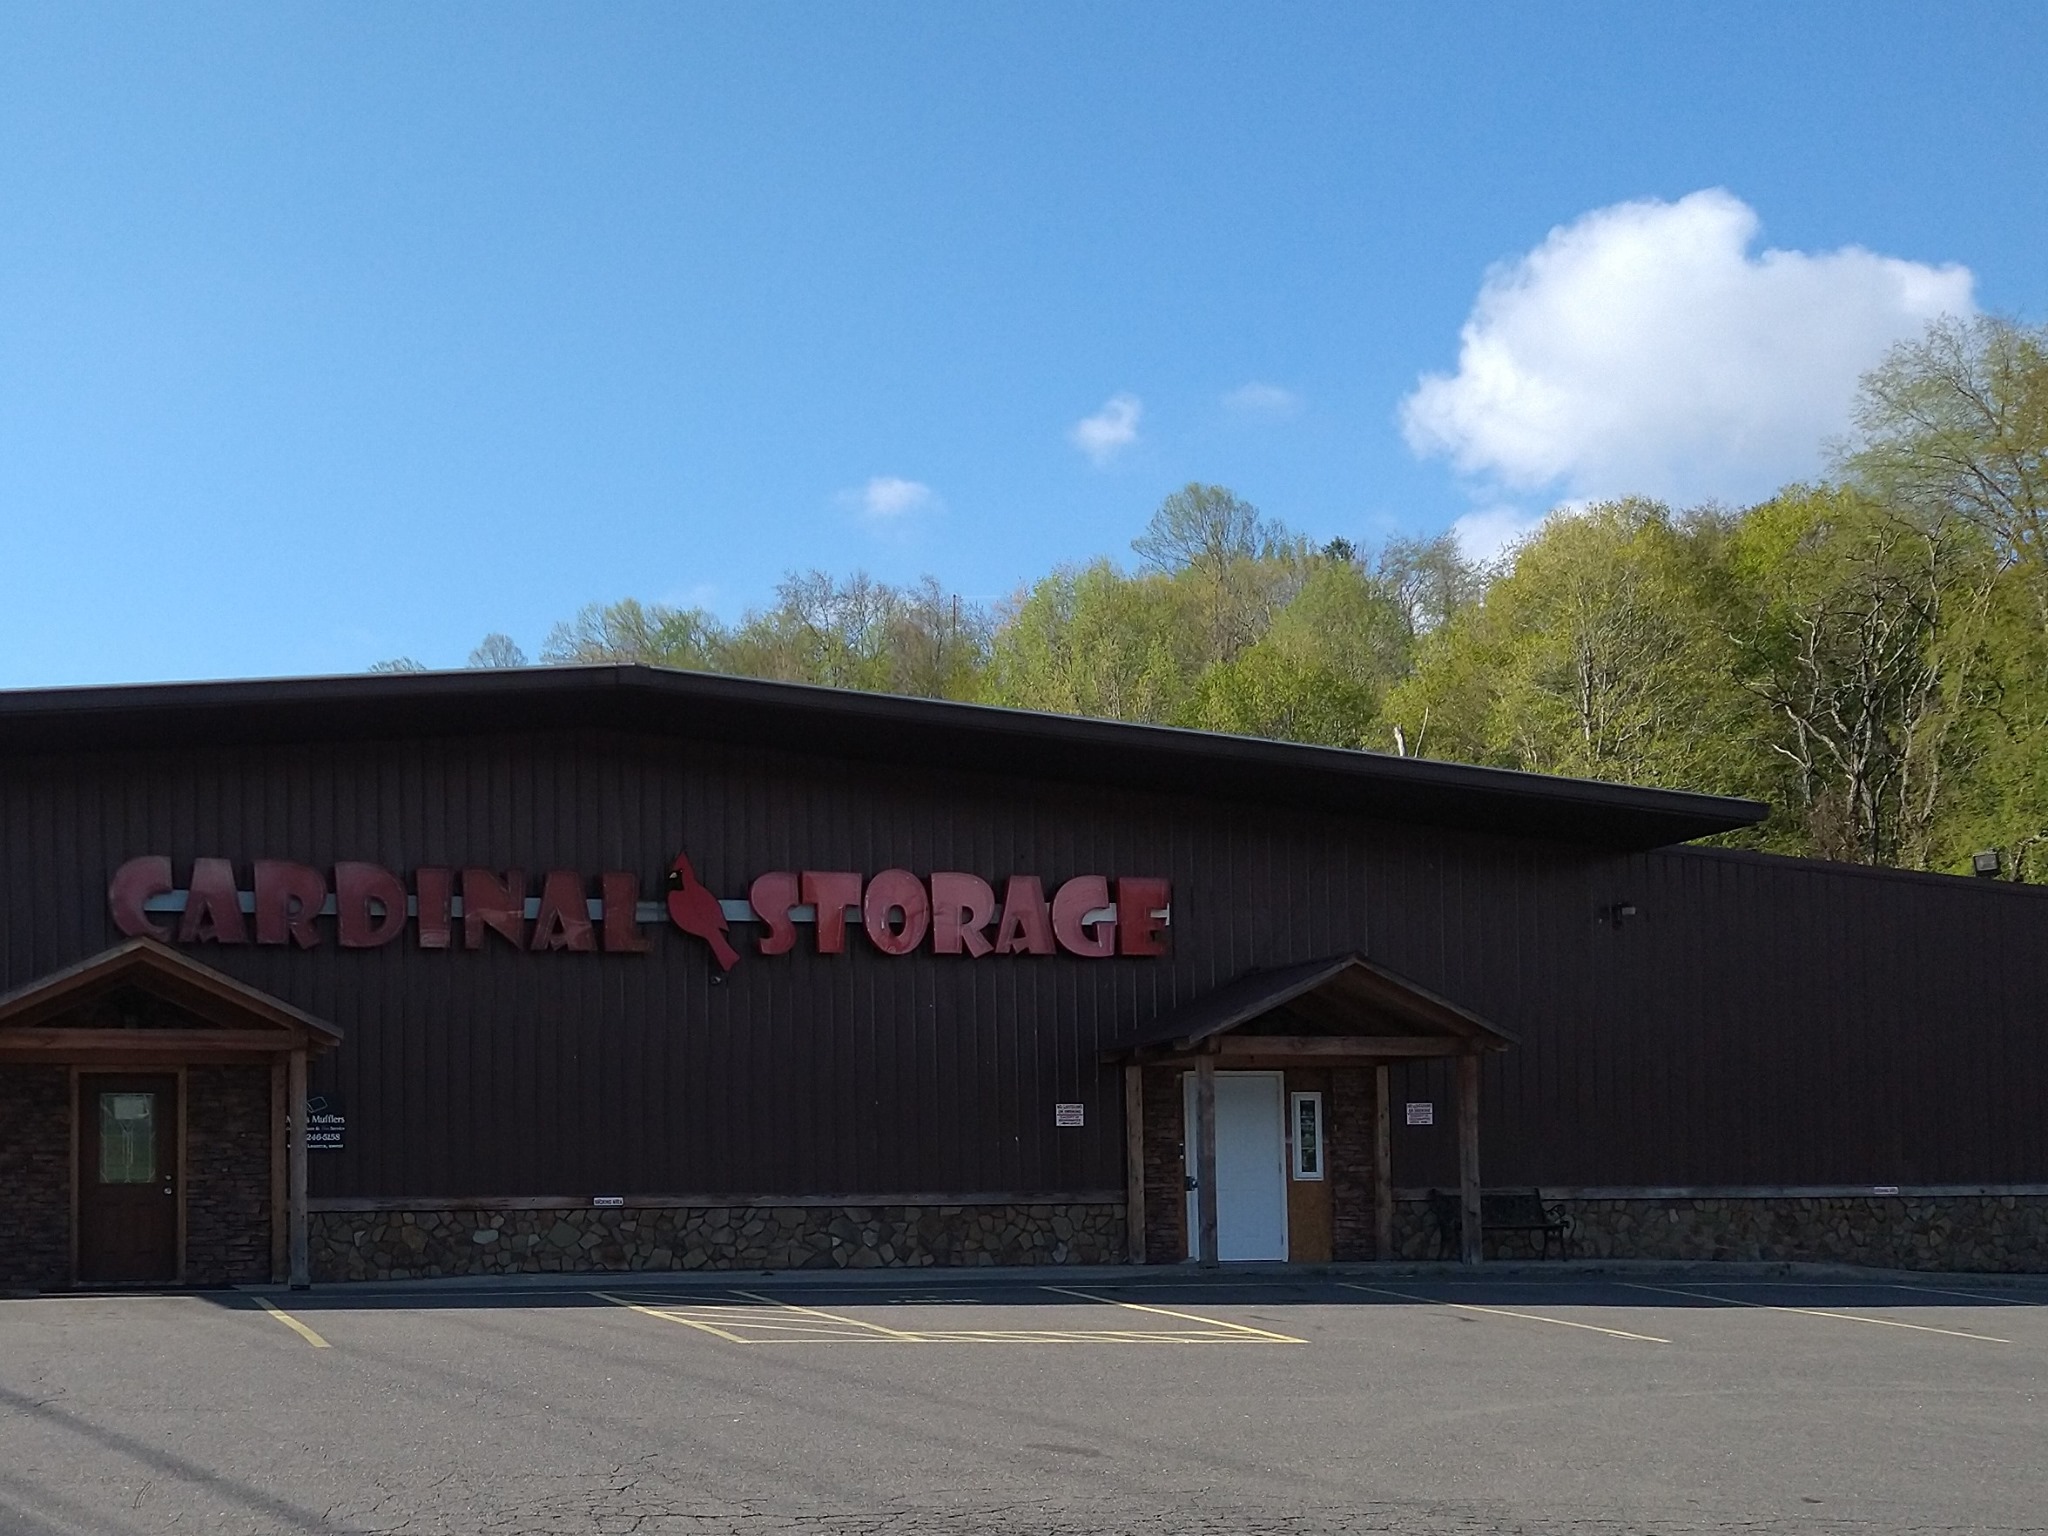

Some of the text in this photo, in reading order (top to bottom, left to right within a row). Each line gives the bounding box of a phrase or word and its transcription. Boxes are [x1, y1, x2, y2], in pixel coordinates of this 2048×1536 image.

[109, 854, 1172, 958] CARDINAL STORAGE
[312, 1115, 345, 1123] Mufflers
